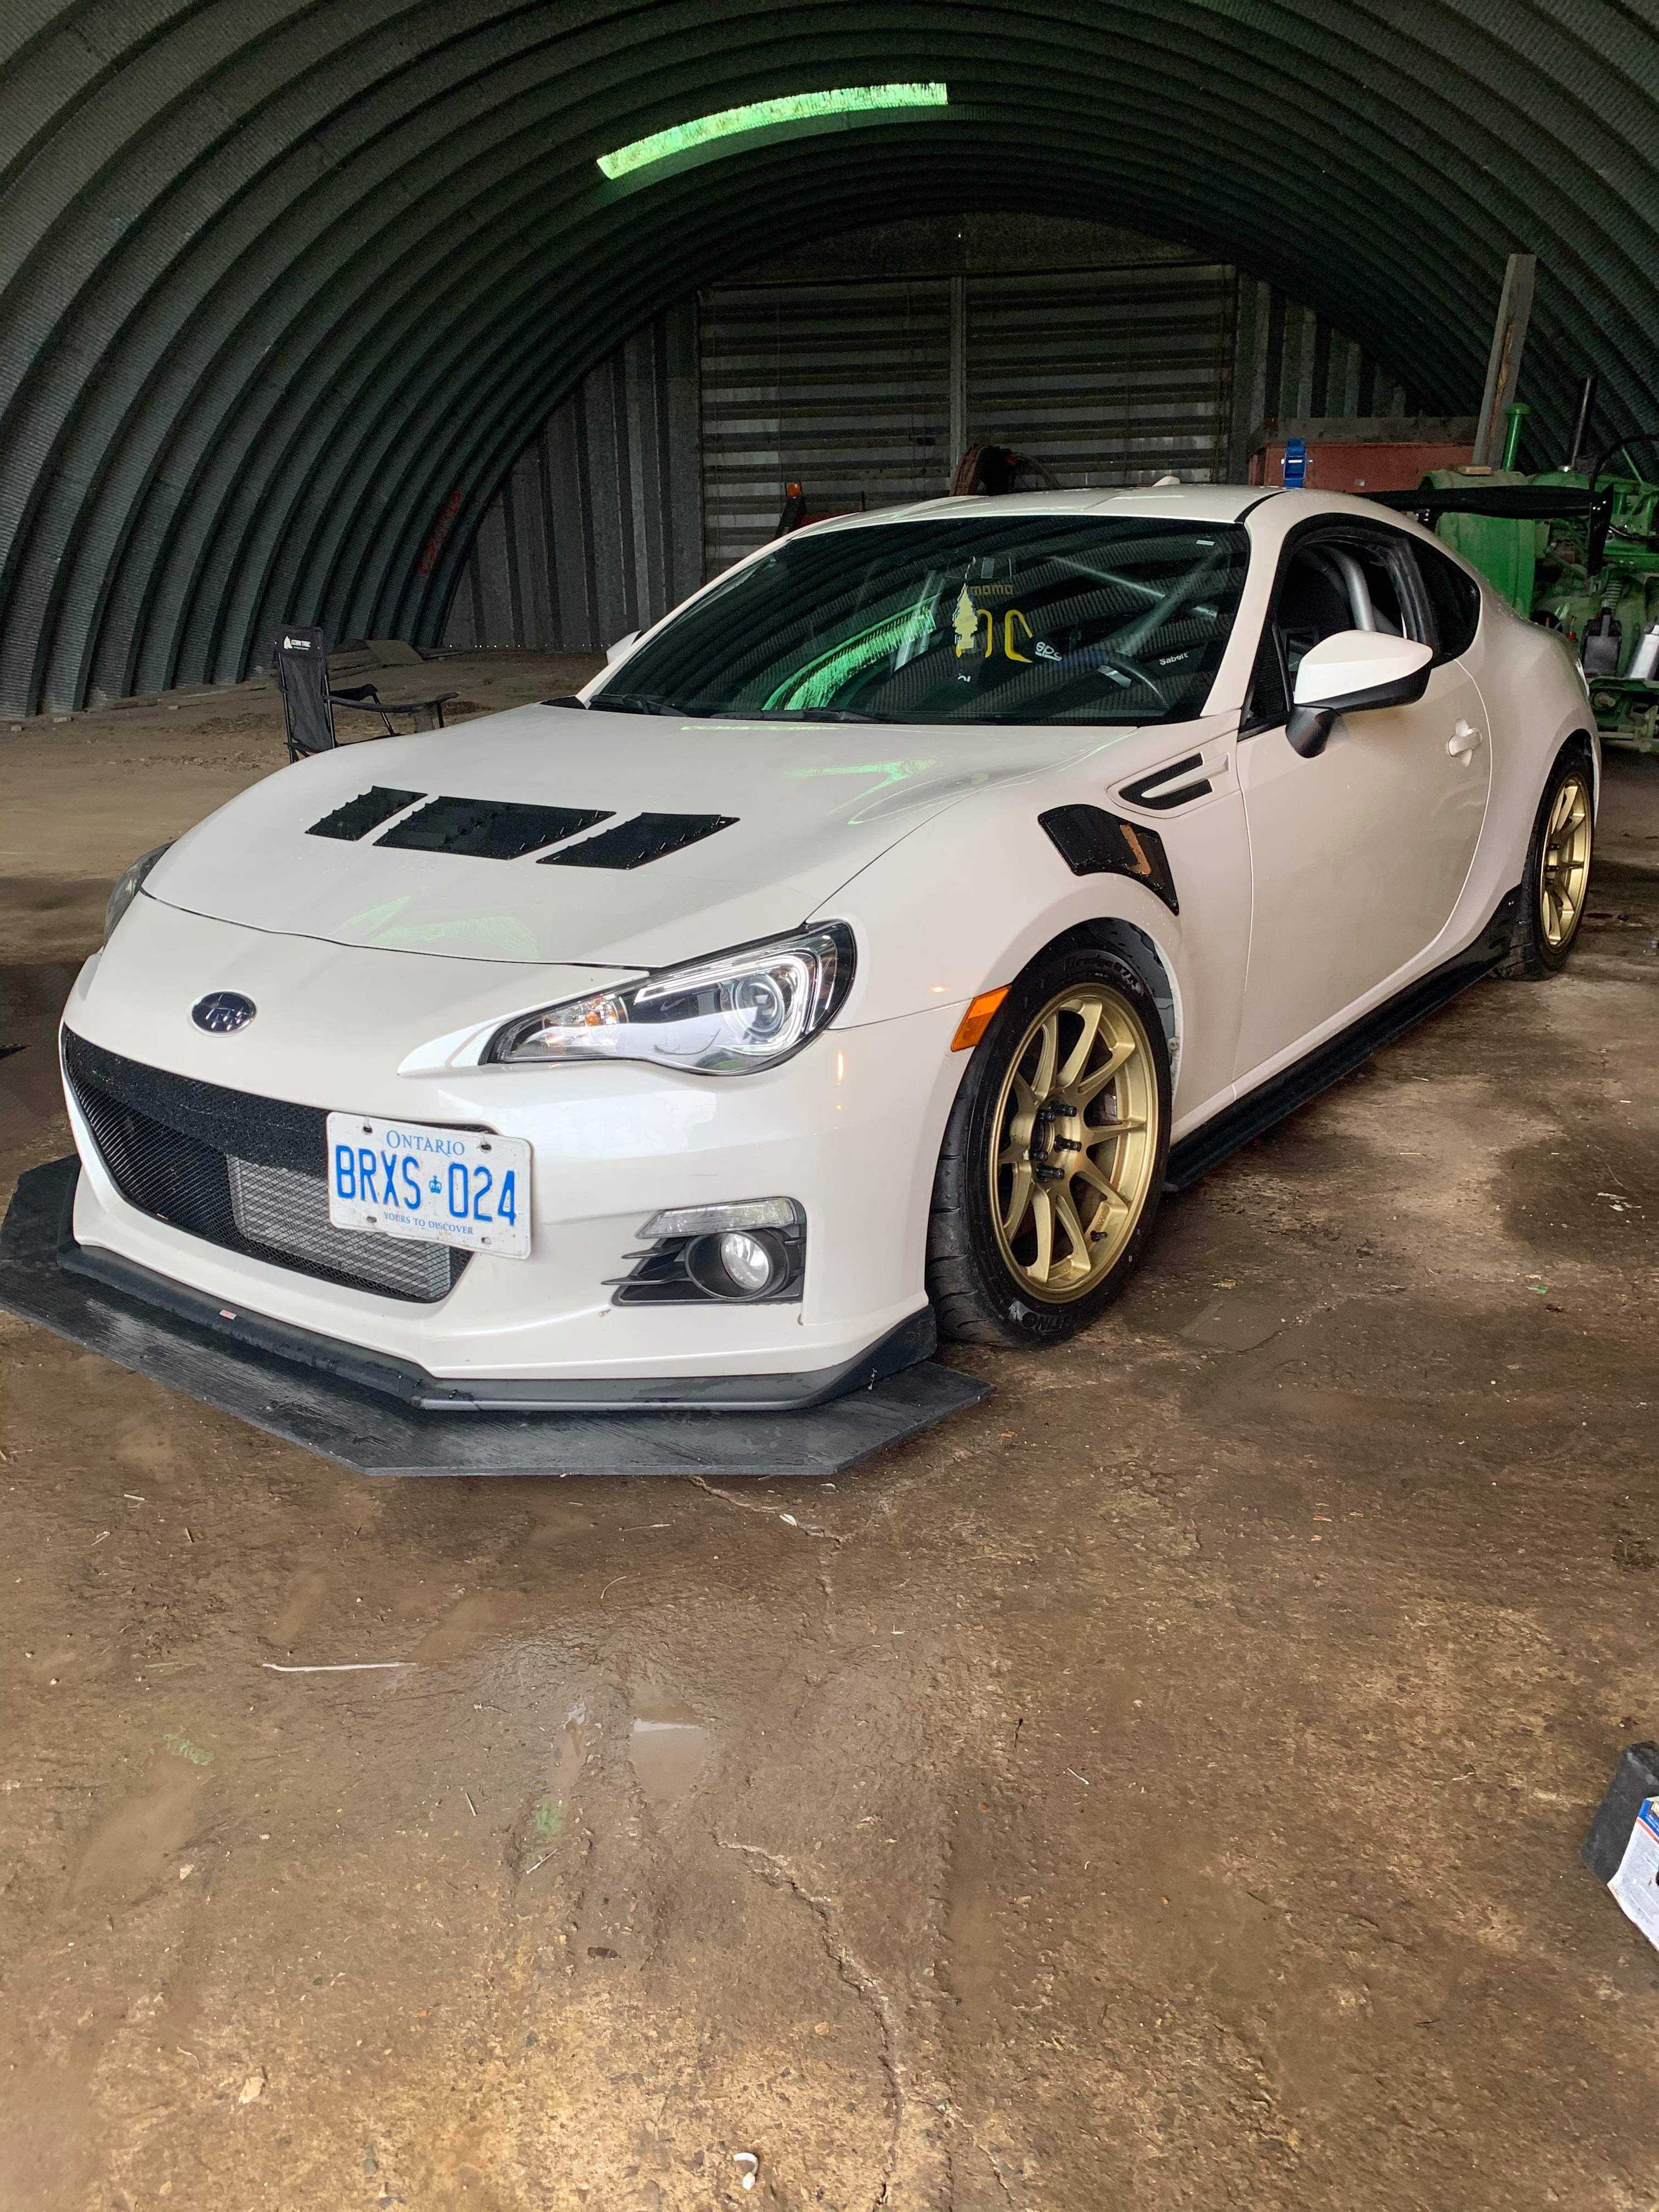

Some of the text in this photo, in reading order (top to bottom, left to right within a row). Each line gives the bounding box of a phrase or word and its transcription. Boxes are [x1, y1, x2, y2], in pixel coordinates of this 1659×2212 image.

[1159, 651, 1189, 665] Sabelt
[386, 1130, 465, 1157] ONTARIO
[335, 1144, 516, 1226] BRXS 024
[384, 1212, 473, 1235] YOURS TO DISCOVER
